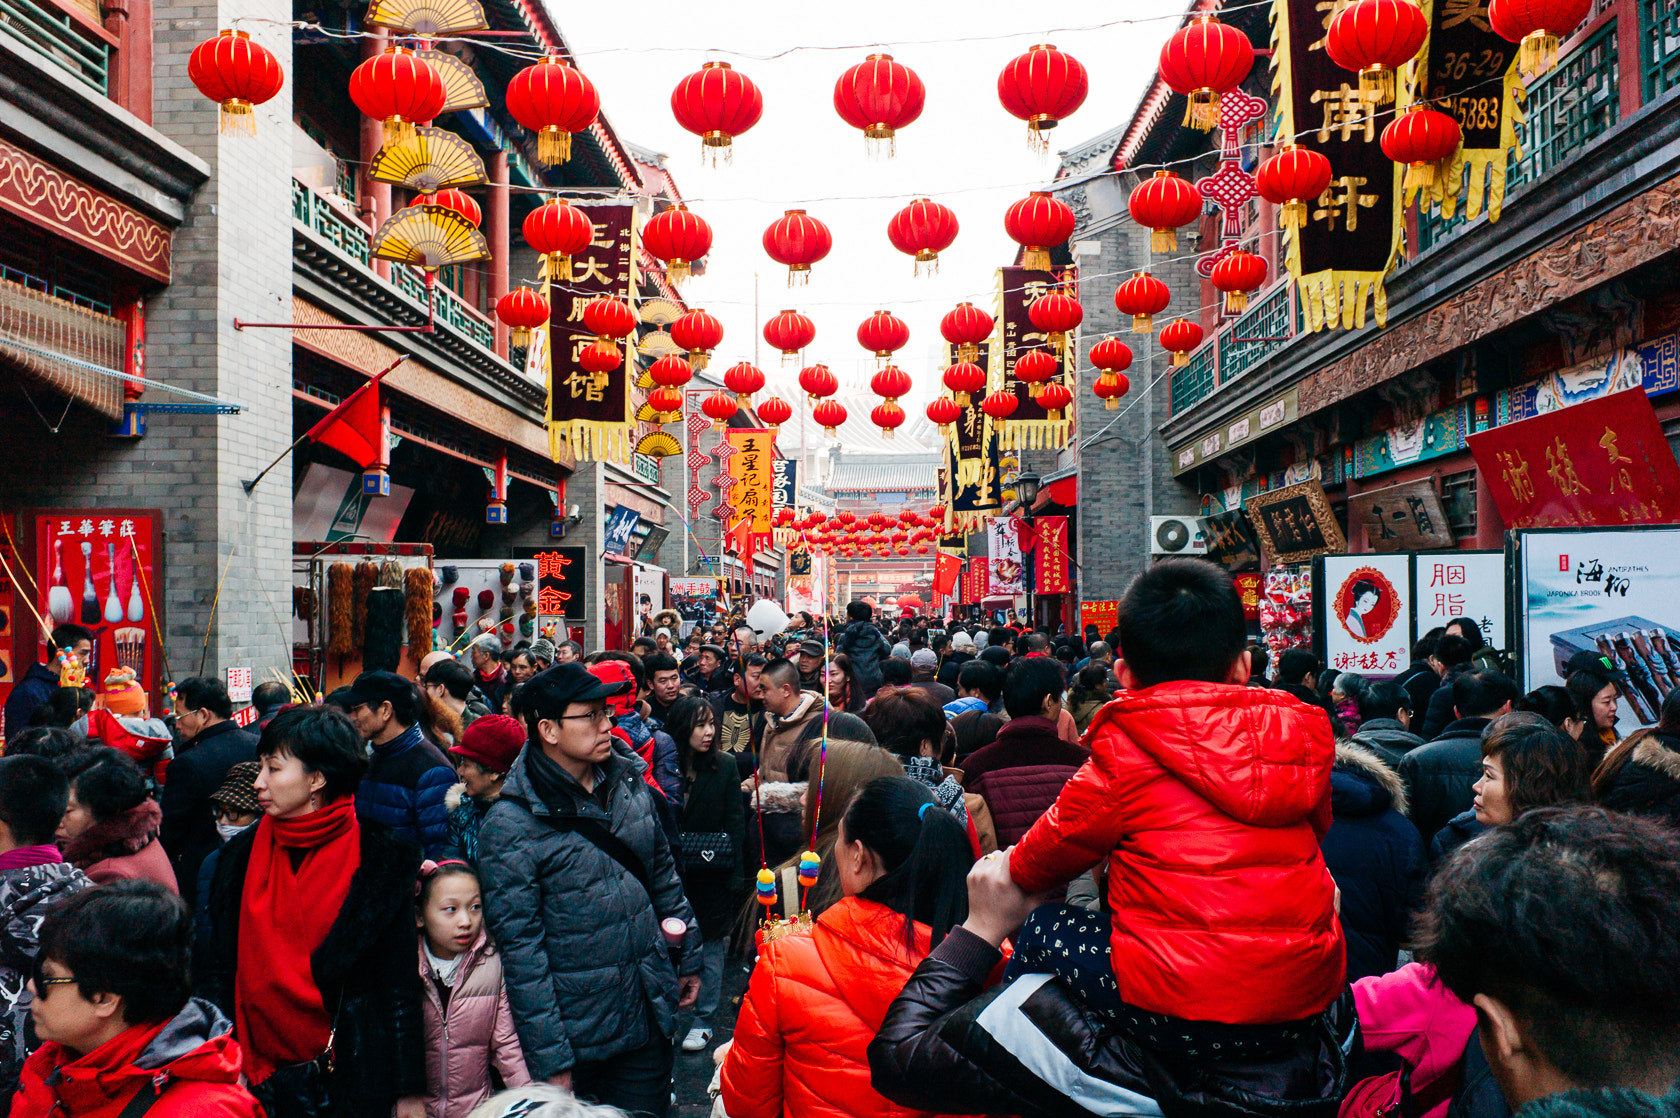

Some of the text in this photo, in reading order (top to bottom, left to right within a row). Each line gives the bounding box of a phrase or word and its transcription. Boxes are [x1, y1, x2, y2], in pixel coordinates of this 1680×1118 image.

[1308, 0, 1379, 232] 南轩
[533, 551, 572, 615] 黄金
[1430, 563, 1466, 617] 胭脂
